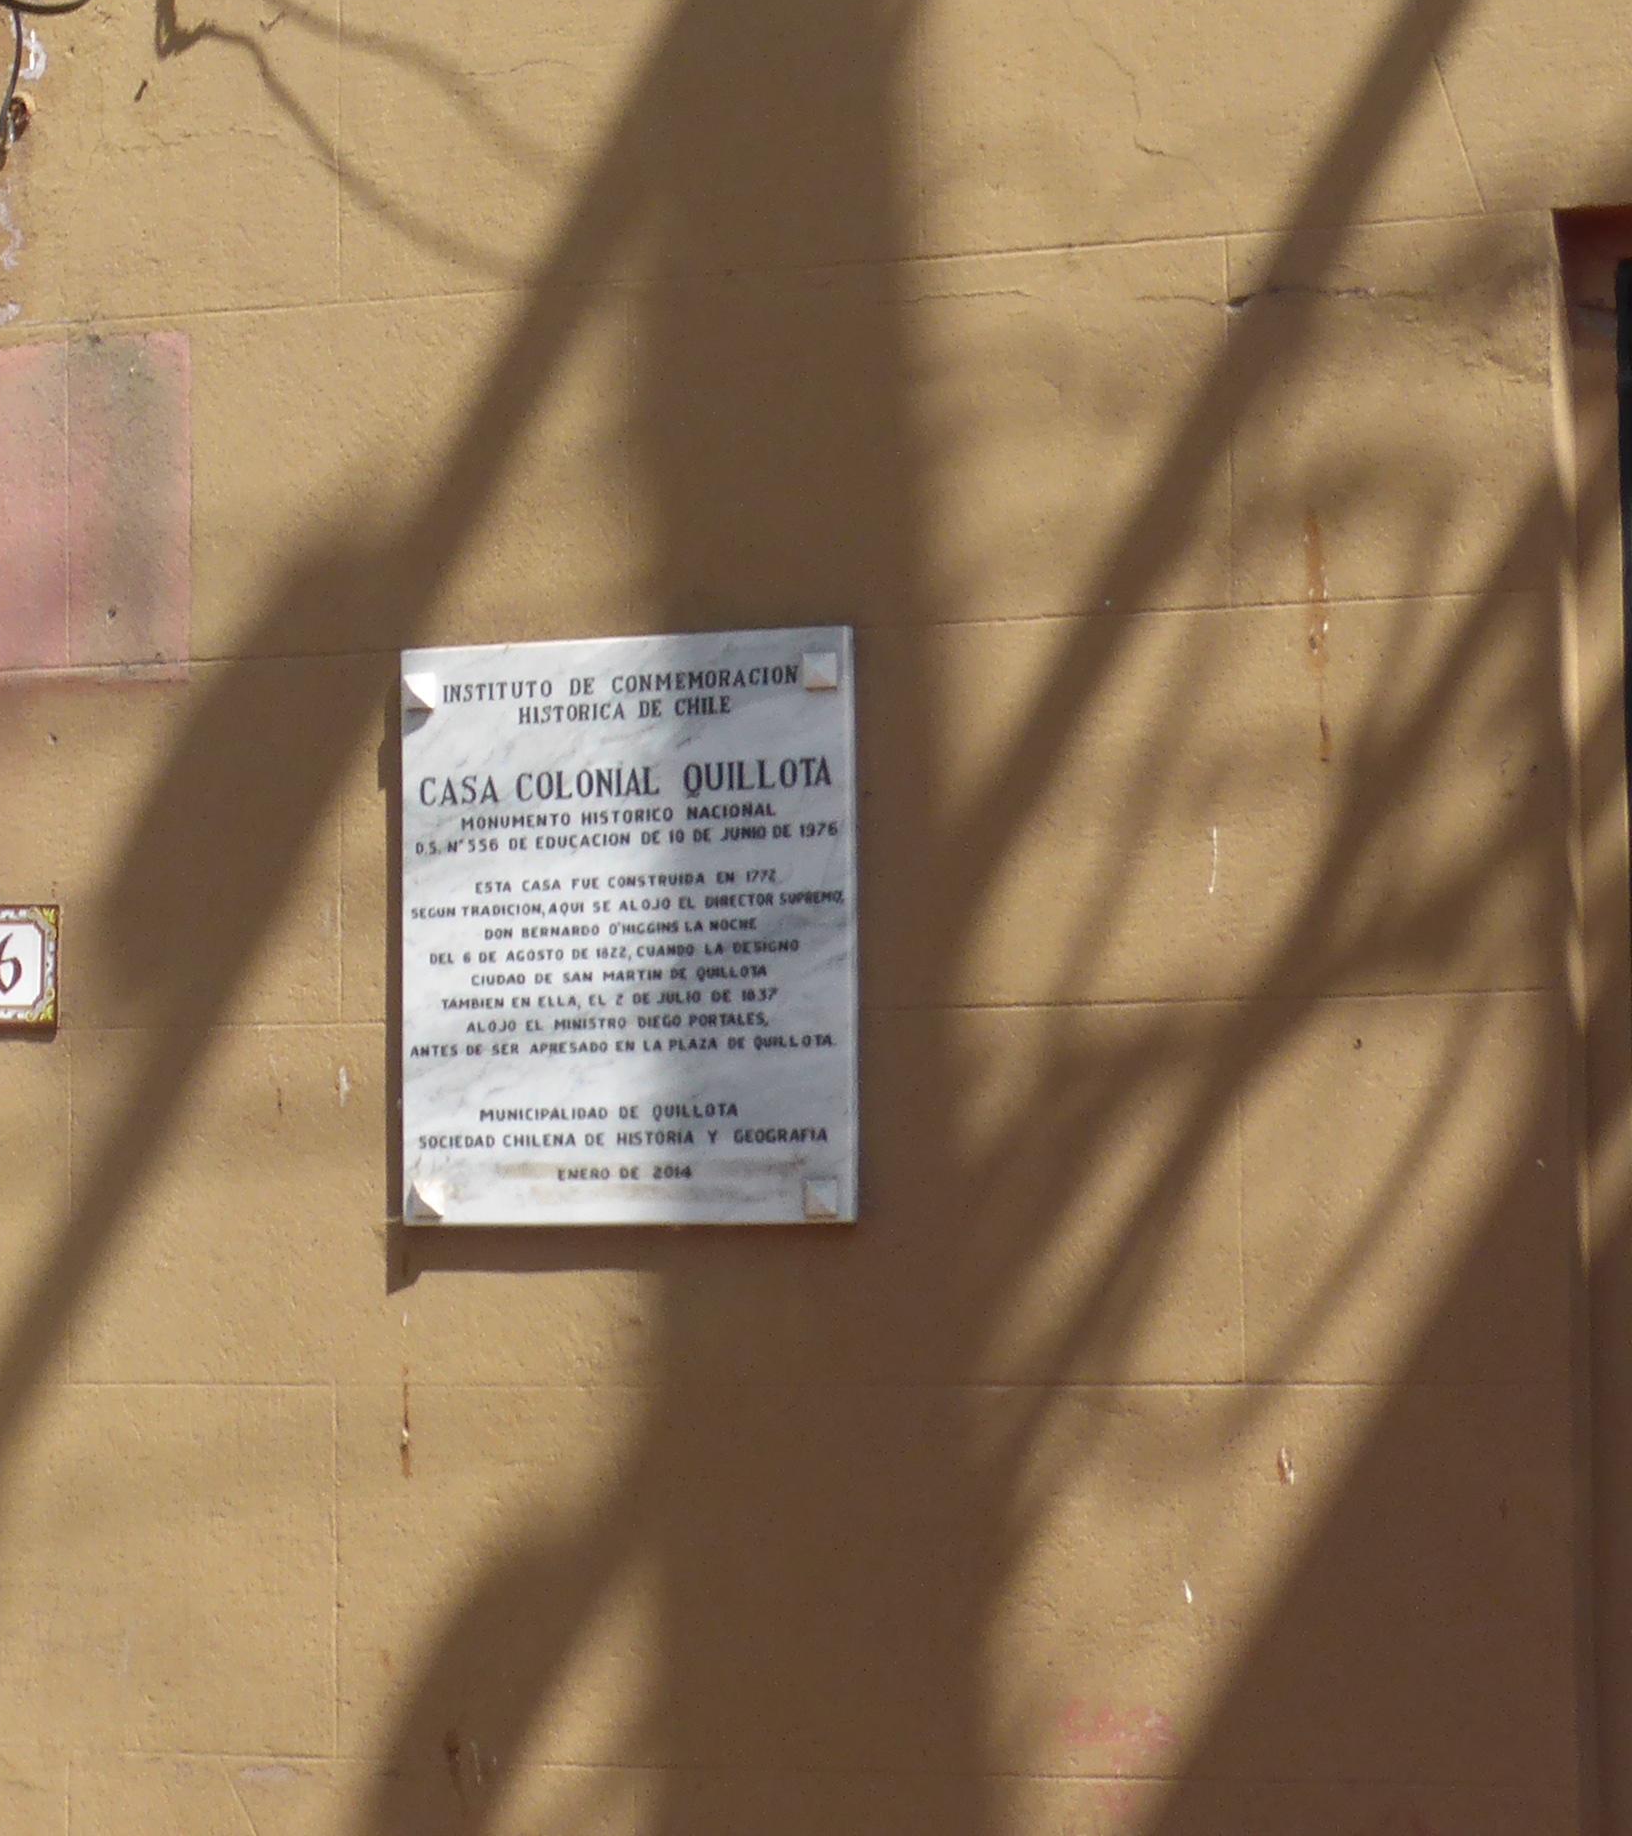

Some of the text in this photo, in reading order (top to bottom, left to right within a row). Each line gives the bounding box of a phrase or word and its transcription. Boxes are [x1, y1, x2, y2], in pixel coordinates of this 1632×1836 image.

[443, 665, 800, 703] INSTITUTO DE CONMEMORACION
[518, 696, 731, 725] HISTORICA DE CHILE
[419, 756, 831, 806] CASA COLONIAL QUILLOTA
[461, 803, 776, 831] MONUMENTO HISTORICO NACIONAL
[509, 837, 528, 851] DE
[536, 832, 631, 850] EDUCACION
[641, 830, 660, 845] DE
[693, 828, 711, 842] DE
[721, 825, 766, 842] JUNIO
[772, 824, 791, 838] DE
[800, 822, 838, 837] 1976
[475, 880, 511, 895] ESTA
[522, 879, 561, 892] CASA
[571, 877, 599, 890] FUE
[608, 871, 705, 889] CONSTRUIDA
[716, 871, 735, 884] EN
[411, 907, 456, 919] SEGUN
[593, 901, 610, 913] SE
[619, 897, 670, 911] ALOJO
[678, 897, 695, 909] EL
[705, 892, 773, 909] DIRECTOR
[484, 917, 757, 940] DON BERNARDO O'HIGGINS LA NOCHE
[429, 952, 454, 965] DEL
[463, 951, 470, 963] 6
[478, 951, 496, 963] DE
[505, 949, 564, 962] AGOSTO
[572, 947, 588, 959] DE
[637, 943, 695, 958] CUANDO
[704, 942, 723, 955] LA
[733, 940, 800, 954] DESIGNO
[471, 964, 767, 986] CIUDAD DE SAN MARTIN DE QUILLOTA
[441, 997, 504, 1010] TAMBIEN
[512, 996, 530, 1008] EN
[538, 995, 581, 1010] ELLA,
[588, 994, 606, 1006] EL
[633, 991, 649, 1004] DE
[657, 989, 700, 1004] JULIO
[711, 989, 731, 1002] DE
[466, 1019, 516, 1033] ALOJO
[526, 1019, 543, 1031] EL
[554, 1016, 627, 1031] MINISTRO
[637, 1014, 681, 1028] DIEGO
[410, 1044, 458, 1058] ANTES
[466, 1043, 483, 1056] DE
[491, 1043, 519, 1055] SER
[530, 1041, 608, 1055] APRESADO
[615, 1039, 635, 1053] EN
[643, 1038, 662, 1051] LA
[669, 1037, 717, 1051] PLAZA
[728, 1036, 745, 1049] DE
[479, 1103, 739, 1122] MUNICIPALIDAD DE QUILLOTA
[418, 1127, 828, 1149] SOCIEDAD CHILENA DE HISTORIA Y GEOGRAFIA
[557, 1165, 692, 1181] ENERO DE 2014
